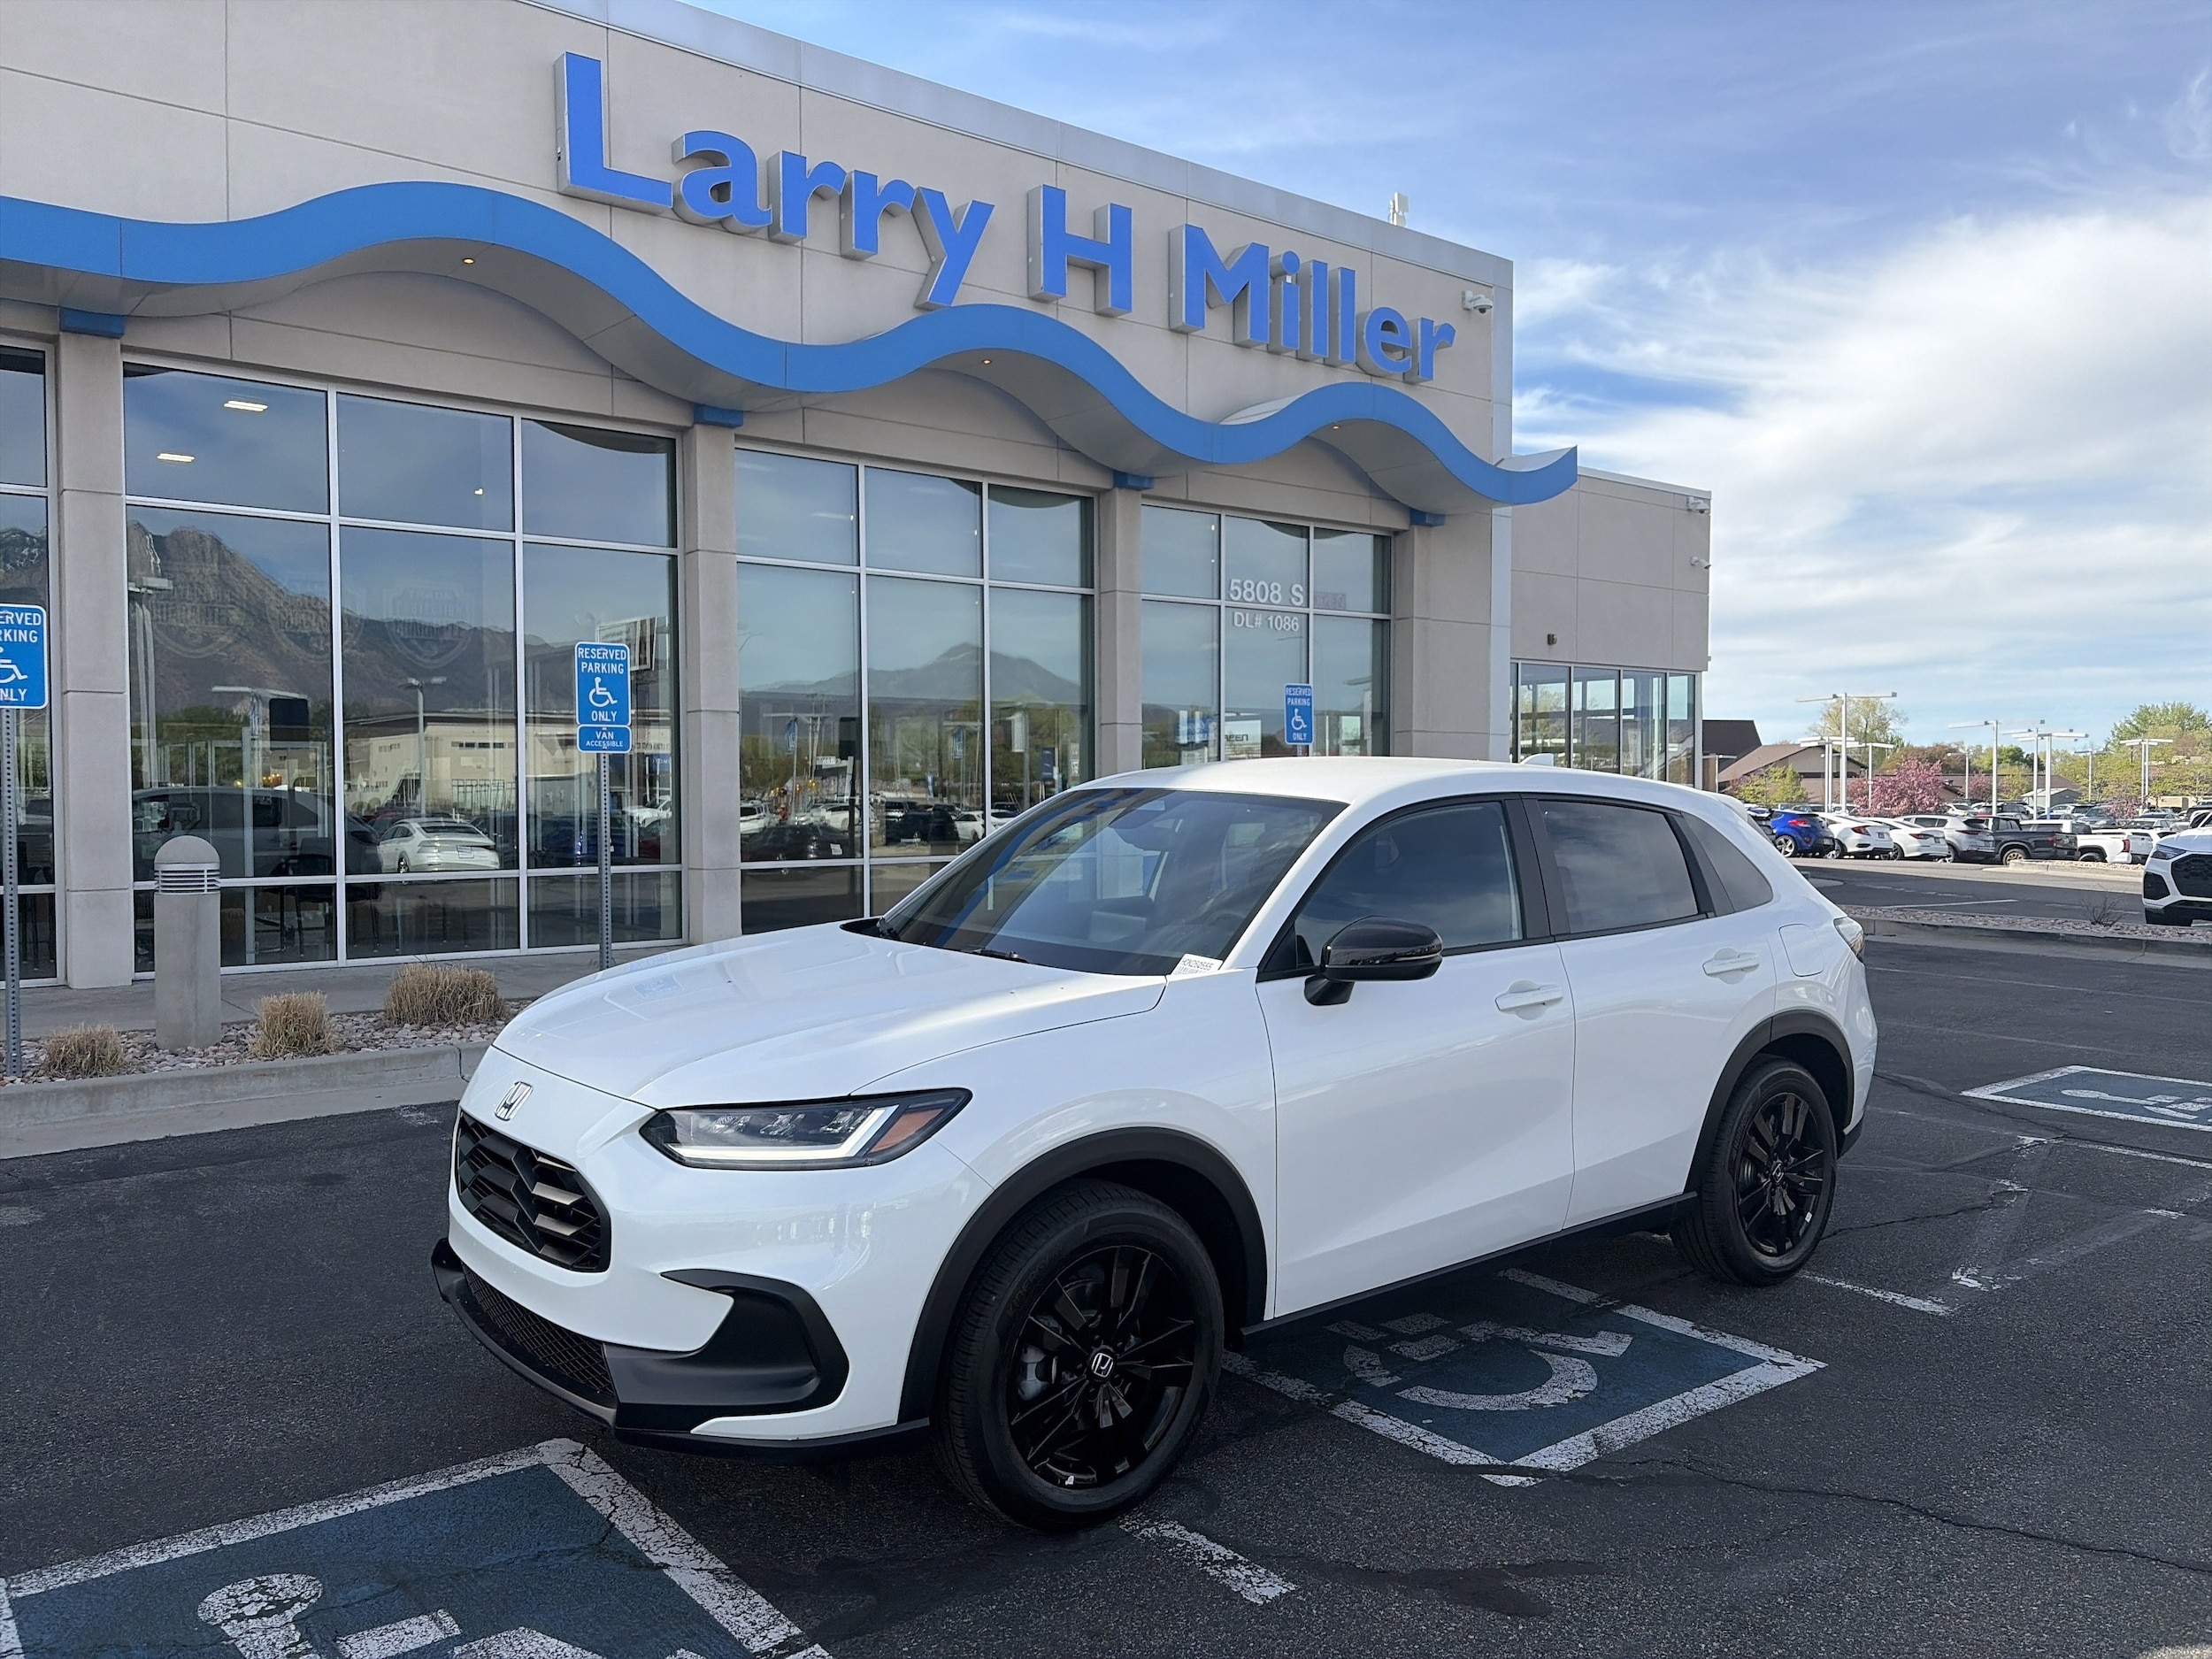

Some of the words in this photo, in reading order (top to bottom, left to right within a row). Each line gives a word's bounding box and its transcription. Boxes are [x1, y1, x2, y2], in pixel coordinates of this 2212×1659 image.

[556, 51, 995, 309] Larry
[1028, 184, 1133, 317] H
[1170, 224, 1455, 384] Miller
[1229, 579, 1282, 603] 5808
[1290, 584, 1304, 606] S
[1233, 611, 1262, 628] DL#
[1267, 615, 1300, 632] 1086
[0, 629, 38, 643] KING
[578, 648, 626, 661] RESERVED
[581, 663, 625, 675] PARKING
[1286, 687, 1312, 696] RESERVED
[1286, 697, 1310, 706] PARKING
[591, 710, 618, 722] ONLY
[595, 731, 614, 740] VAN
